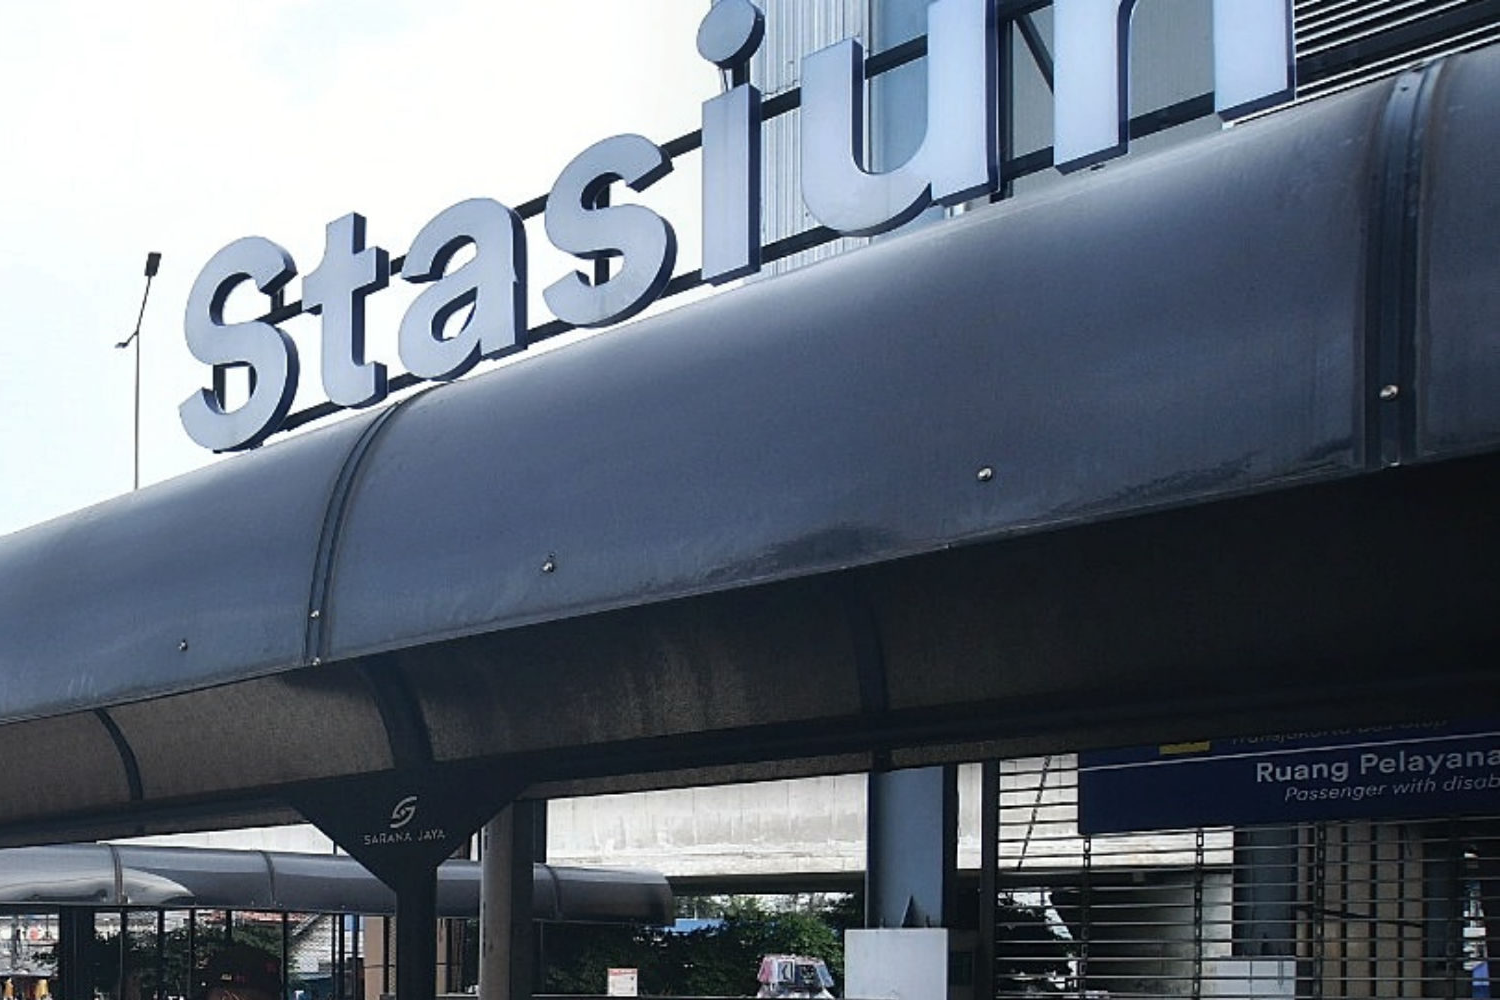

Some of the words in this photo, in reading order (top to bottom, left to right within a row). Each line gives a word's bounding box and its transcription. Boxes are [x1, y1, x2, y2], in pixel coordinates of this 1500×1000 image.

[178, 0, 1296, 454] Stasiun
[1256, 761, 1349, 783] Ruang
[1360, 750, 1500, 775] Pelayana
[1285, 785, 1385, 801] Passenger
[1393, 776, 1436, 795] with
[364, 832, 412, 846] SARANA
[418, 829, 446, 842] JAYA
